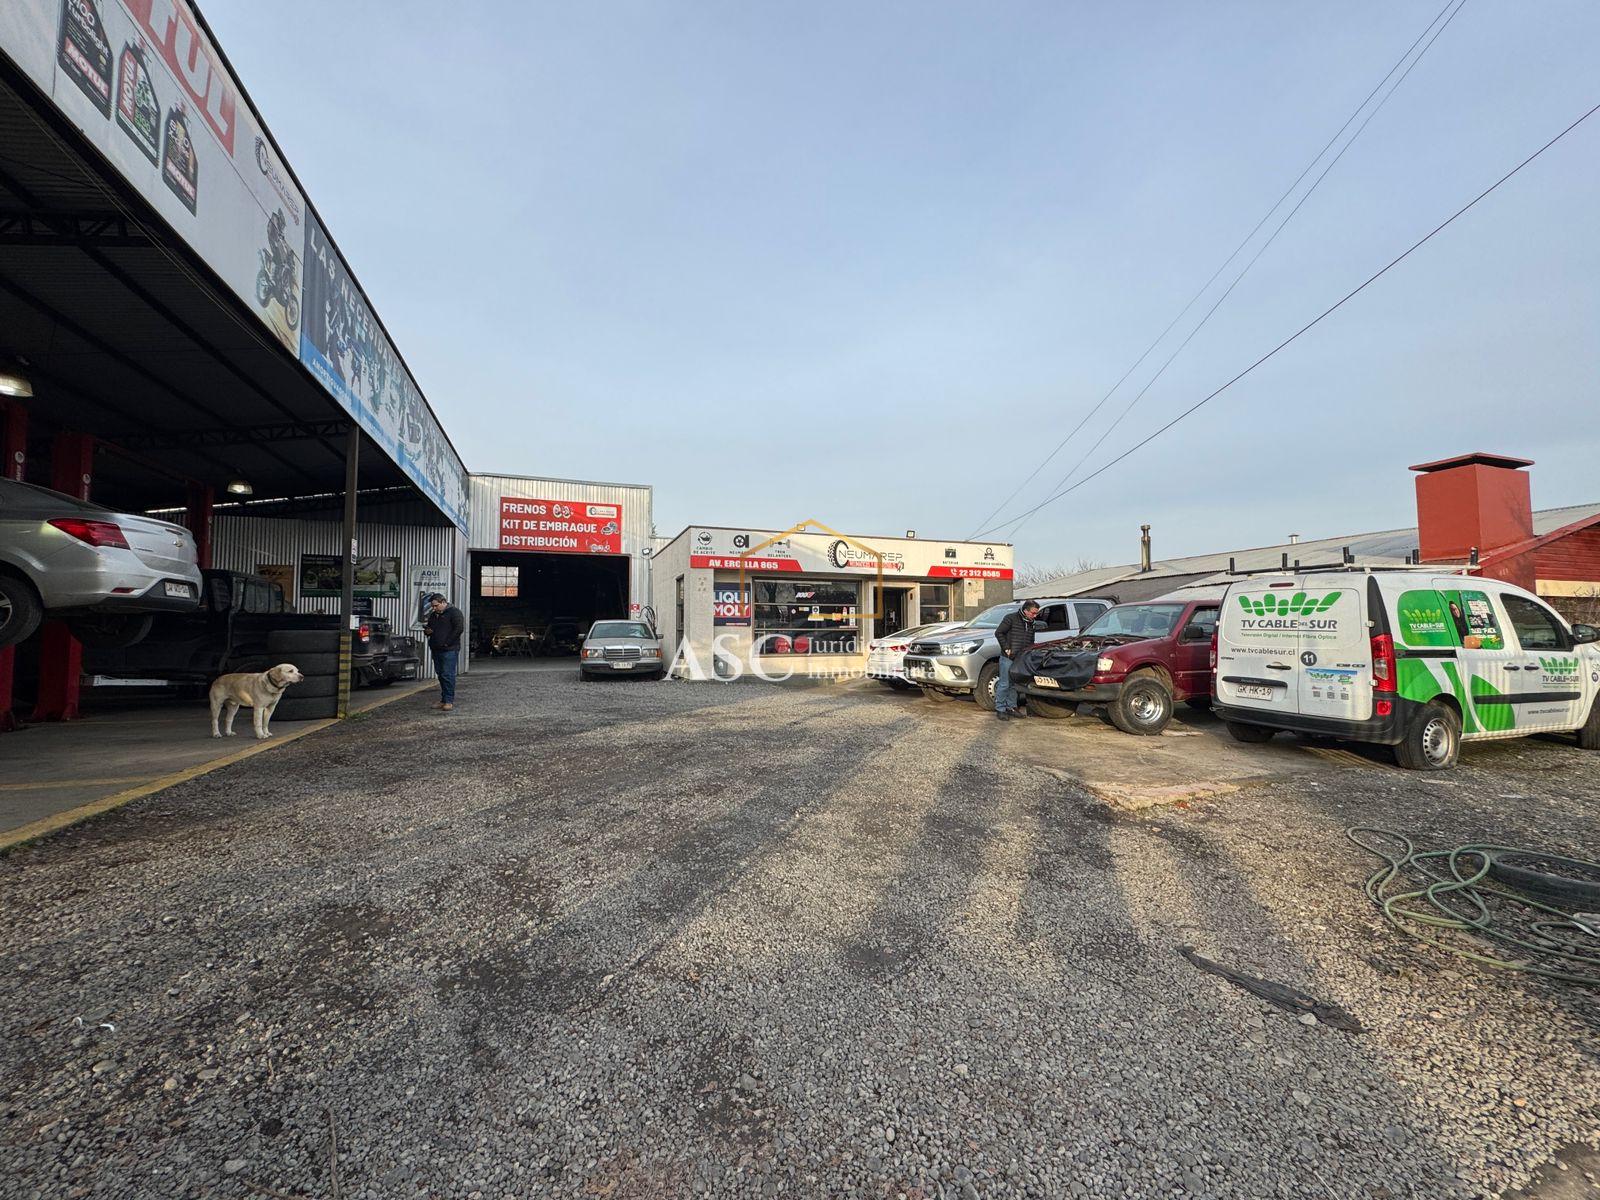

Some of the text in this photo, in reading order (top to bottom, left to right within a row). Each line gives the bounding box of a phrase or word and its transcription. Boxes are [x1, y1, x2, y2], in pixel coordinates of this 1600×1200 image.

[65, 43, 108, 96] MOTUL
[123, 55, 135, 115] MOTUL
[310, 227, 336, 280] LAS
[502, 502, 547, 514] FRENOS
[502, 519, 598, 533] KIT DE EMBRAGUE
[502, 535, 577, 548] DISTRIBUCIÓN
[709, 559, 723, 568] AV.
[760, 561, 779, 569] 865
[713, 604, 749, 617] MOLY
[1241, 620, 1256, 628] TV
[1257, 620, 1298, 629] CABLE
[1309, 620, 1338, 629] SUR
[1231, 647, 1296, 656] www.tvcablesur.cl
[1303, 655, 1315, 664] 11
